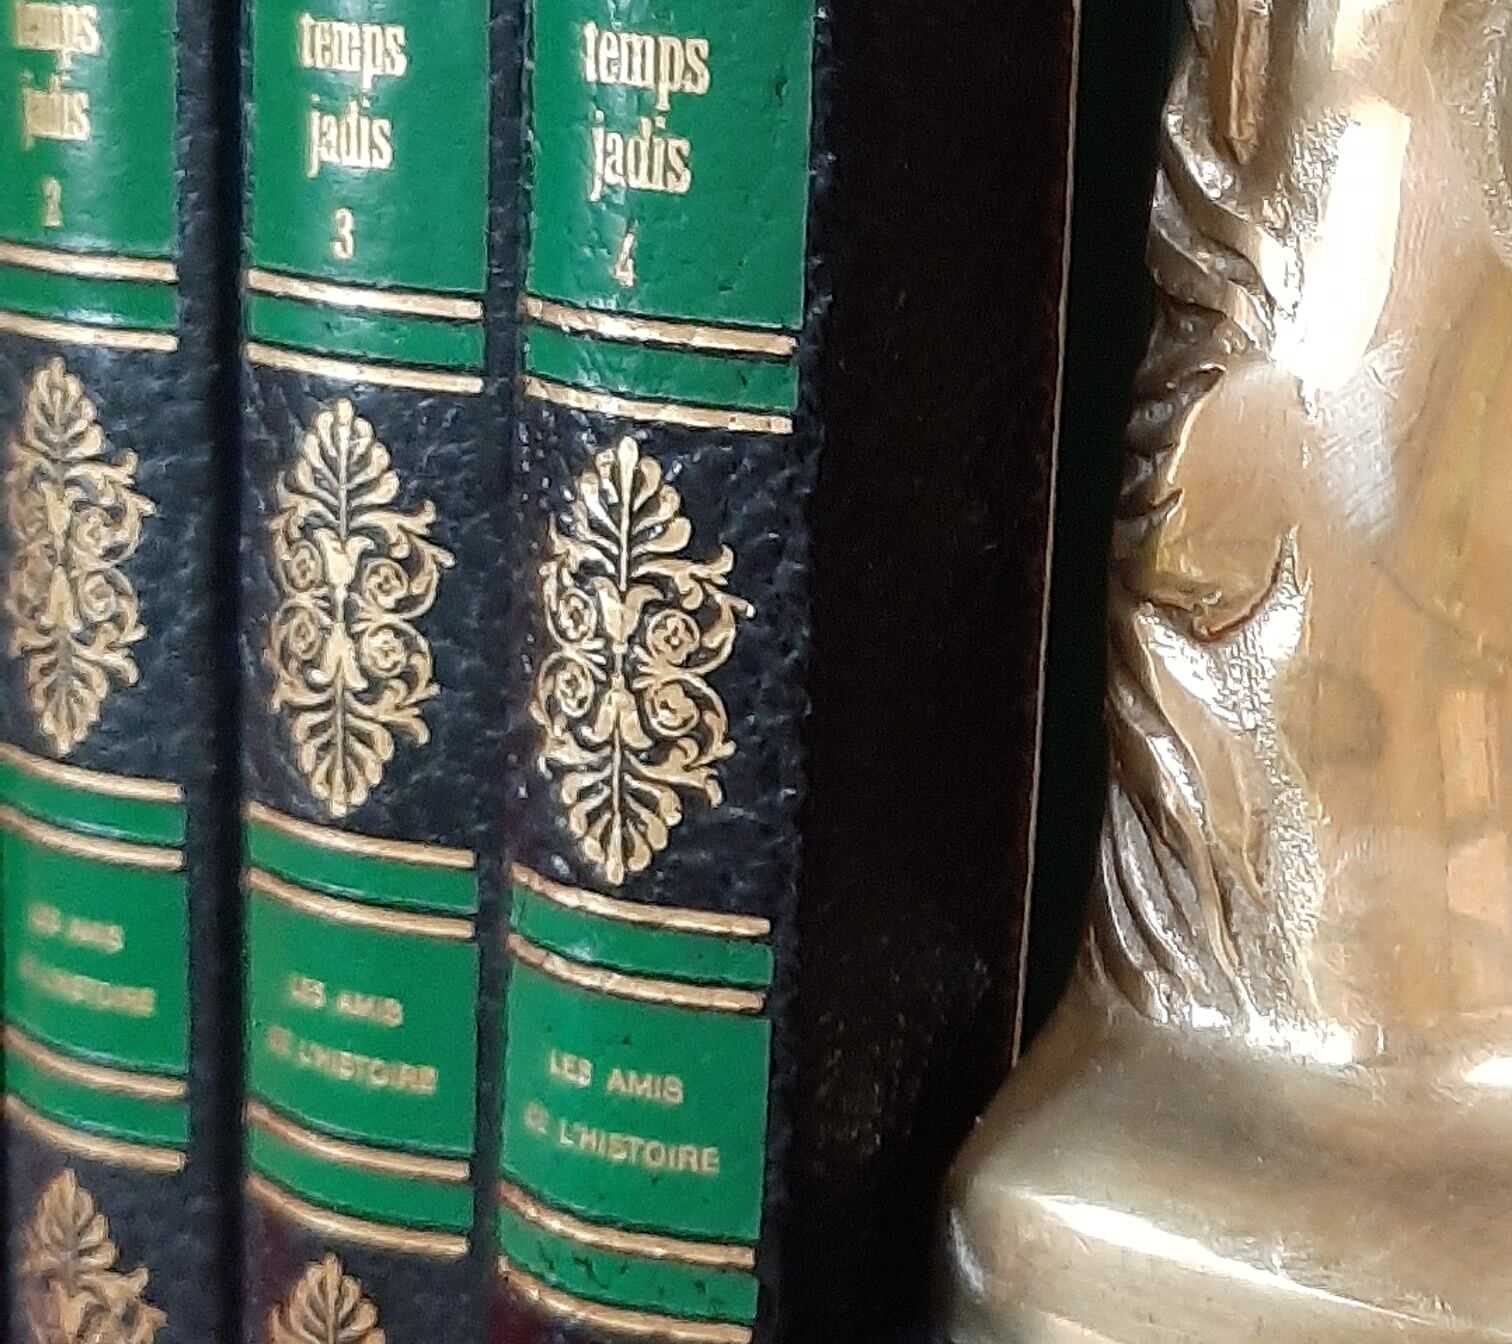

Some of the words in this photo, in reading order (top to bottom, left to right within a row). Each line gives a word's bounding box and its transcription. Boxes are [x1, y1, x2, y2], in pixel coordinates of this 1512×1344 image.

[300, 13, 408, 90] temps
[580, 21, 711, 111] temps
[306, 94, 393, 177] jadis
[589, 110, 691, 202] jadis
[330, 207, 355, 259] 3
[613, 231, 636, 287] 4
[607, 1068, 684, 1105] AMIS
[559, 1119, 720, 1176] L'HISTOIRE
